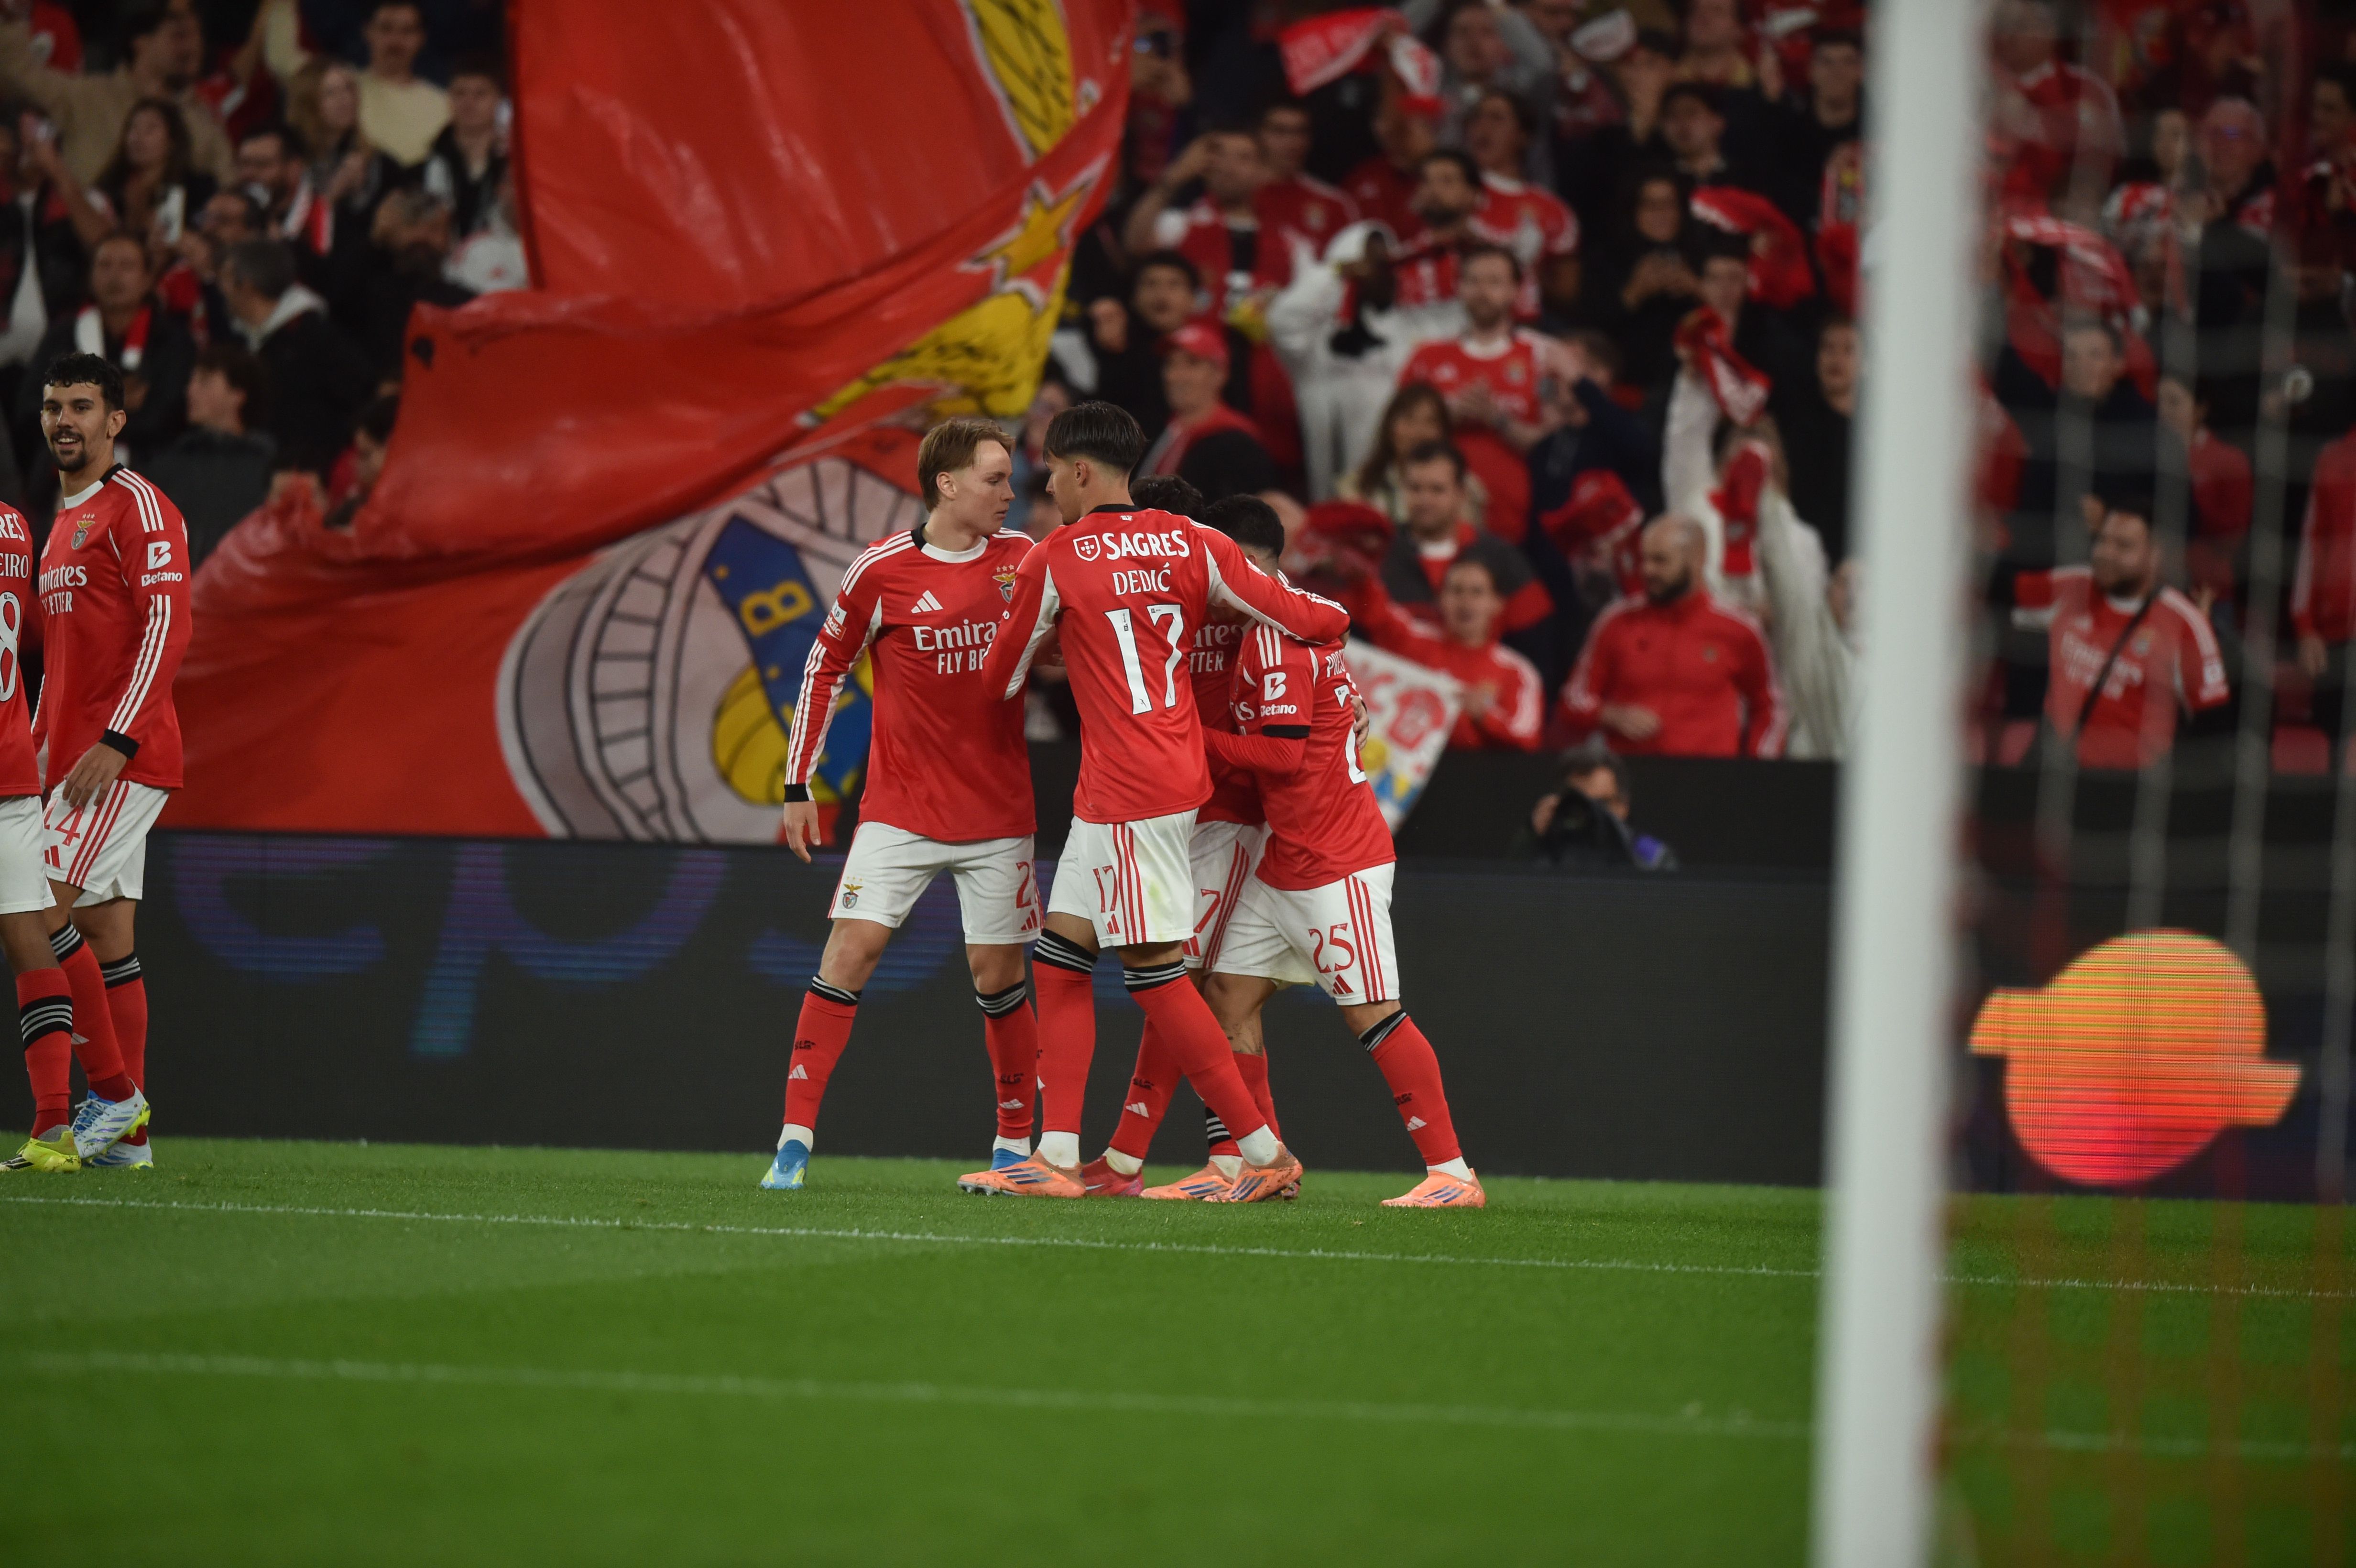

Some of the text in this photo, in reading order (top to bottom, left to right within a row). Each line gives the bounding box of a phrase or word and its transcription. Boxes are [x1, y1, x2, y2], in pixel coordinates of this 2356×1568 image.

[1102, 530, 1189, 560] SAGRES
[39, 563, 87, 596] mirates
[141, 571, 183, 588] Betano
[1112, 562, 1171, 595] DEDIĆ
[913, 619, 1000, 651] Emira
[938, 652, 963, 675] FLY
[1104, 604, 1184, 715] 17
[1260, 704, 1297, 718] Betano
[1015, 861, 1037, 909] 2
[1092, 865, 1118, 913] 17
[1193, 888, 1221, 934] 7
[1308, 923, 1354, 973] 25
